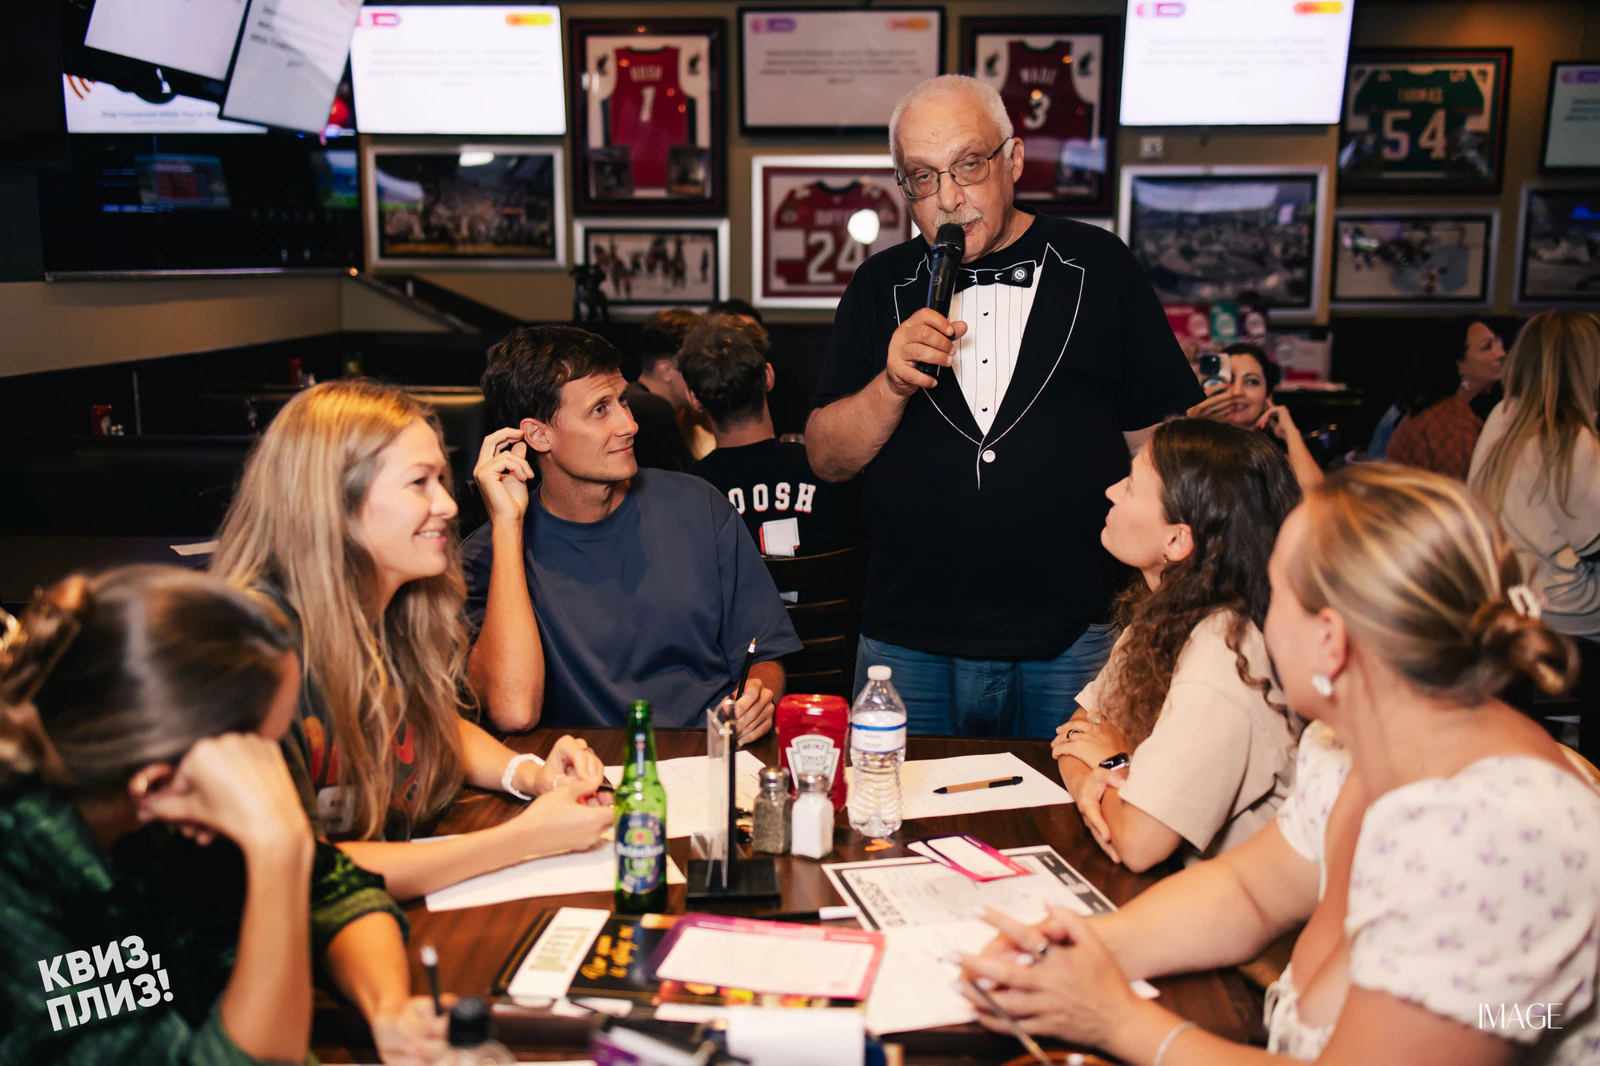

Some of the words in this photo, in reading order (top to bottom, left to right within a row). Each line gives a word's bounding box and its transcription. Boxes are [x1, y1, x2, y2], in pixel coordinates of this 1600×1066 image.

[641, 86, 656, 122] 1
[1023, 91, 1051, 130] 3
[1382, 109, 1447, 160] 54
[807, 231, 867, 283] 24
